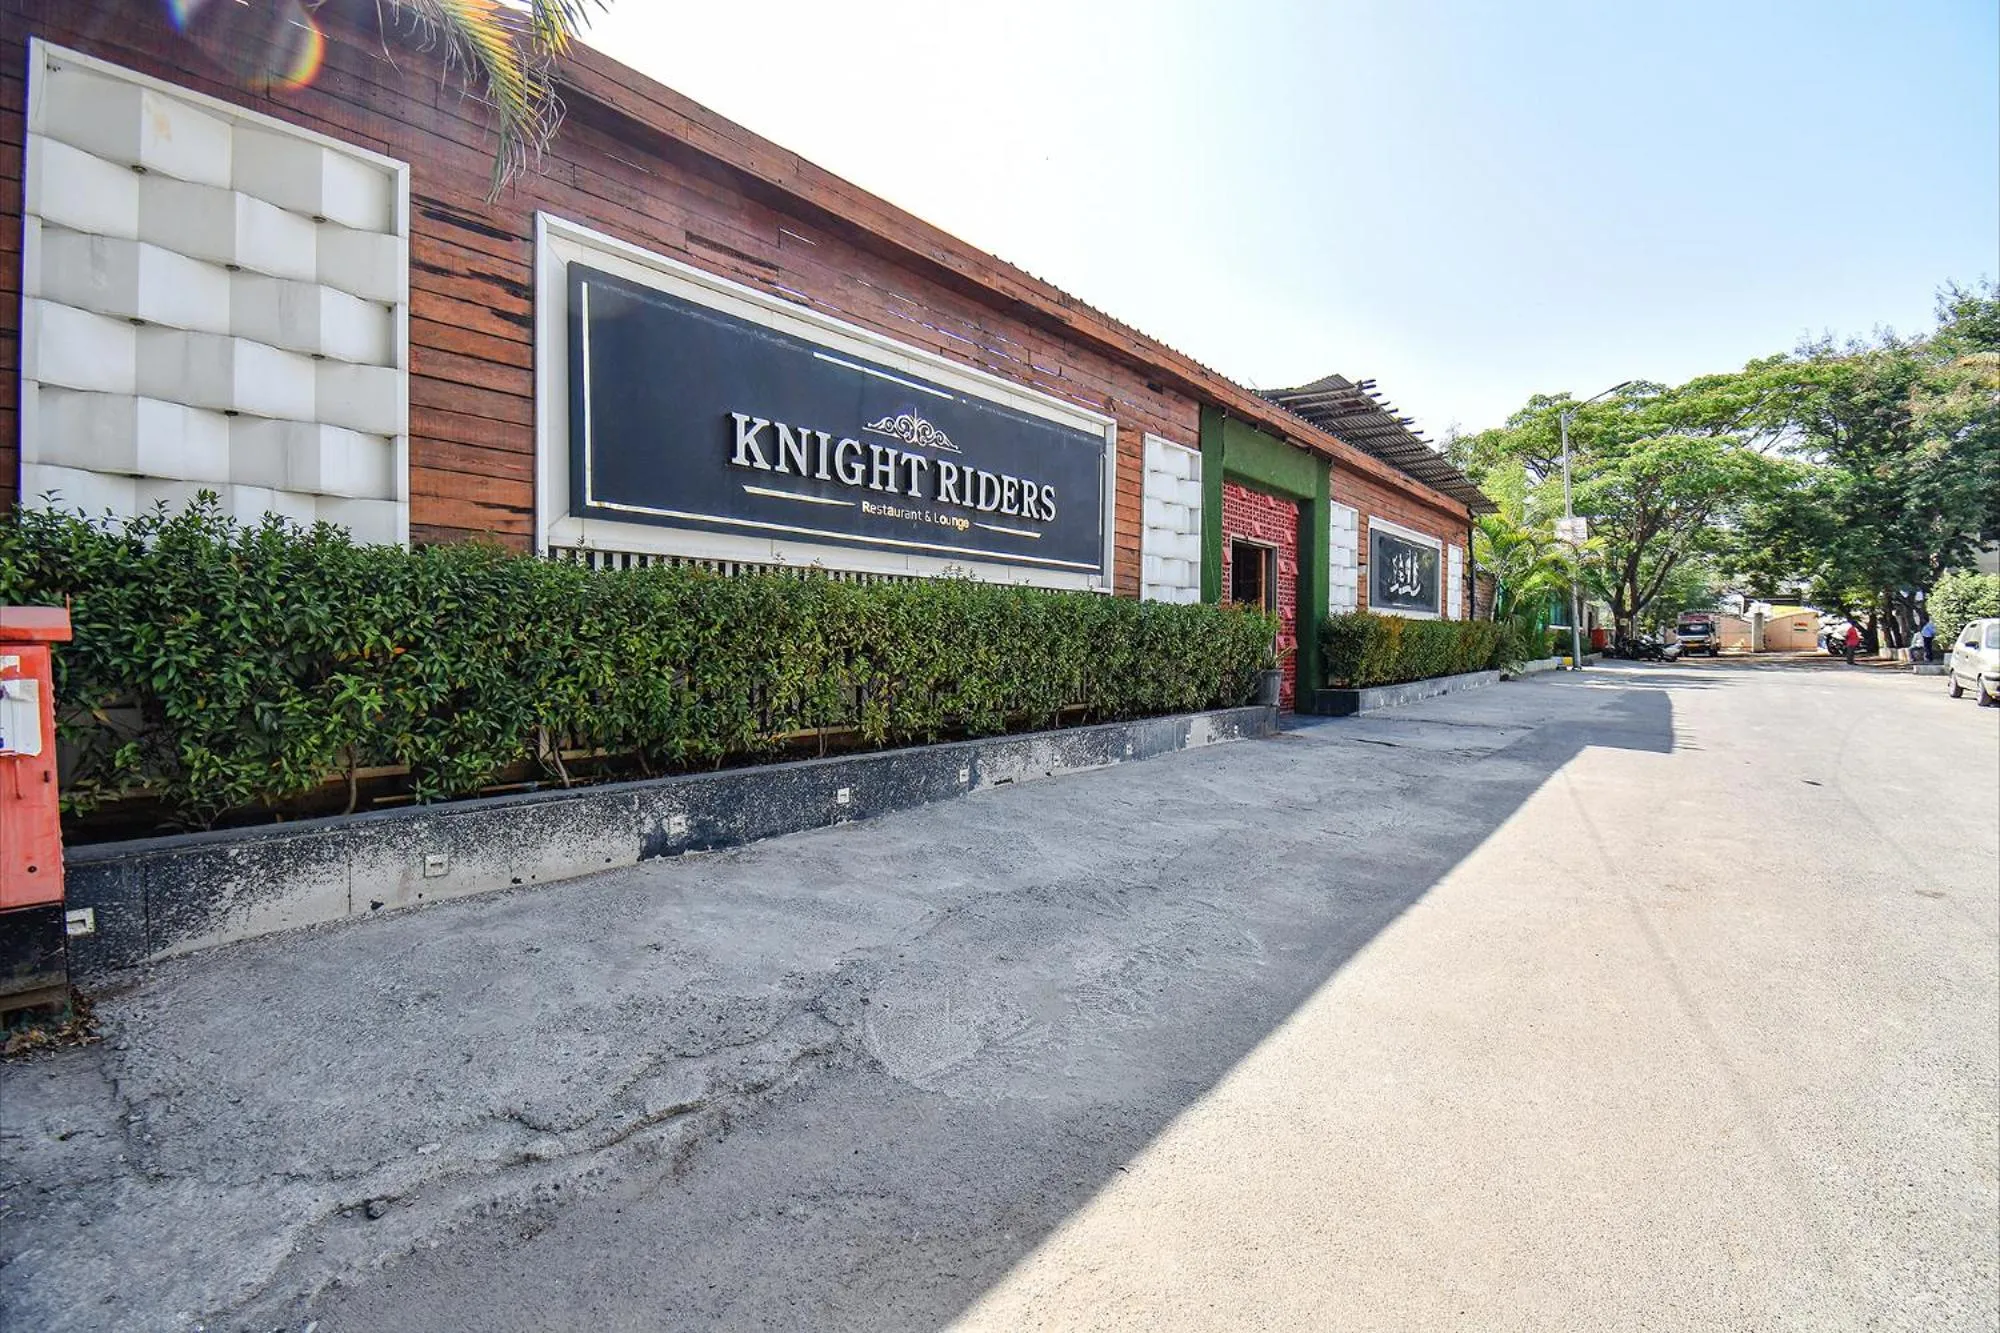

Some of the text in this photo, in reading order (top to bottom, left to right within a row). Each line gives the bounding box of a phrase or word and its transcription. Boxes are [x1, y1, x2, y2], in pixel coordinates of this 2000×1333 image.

[730, 412, 1057, 522] KNIGHT RIDERS
[862, 500, 970, 531] Restaurant & Lounge
